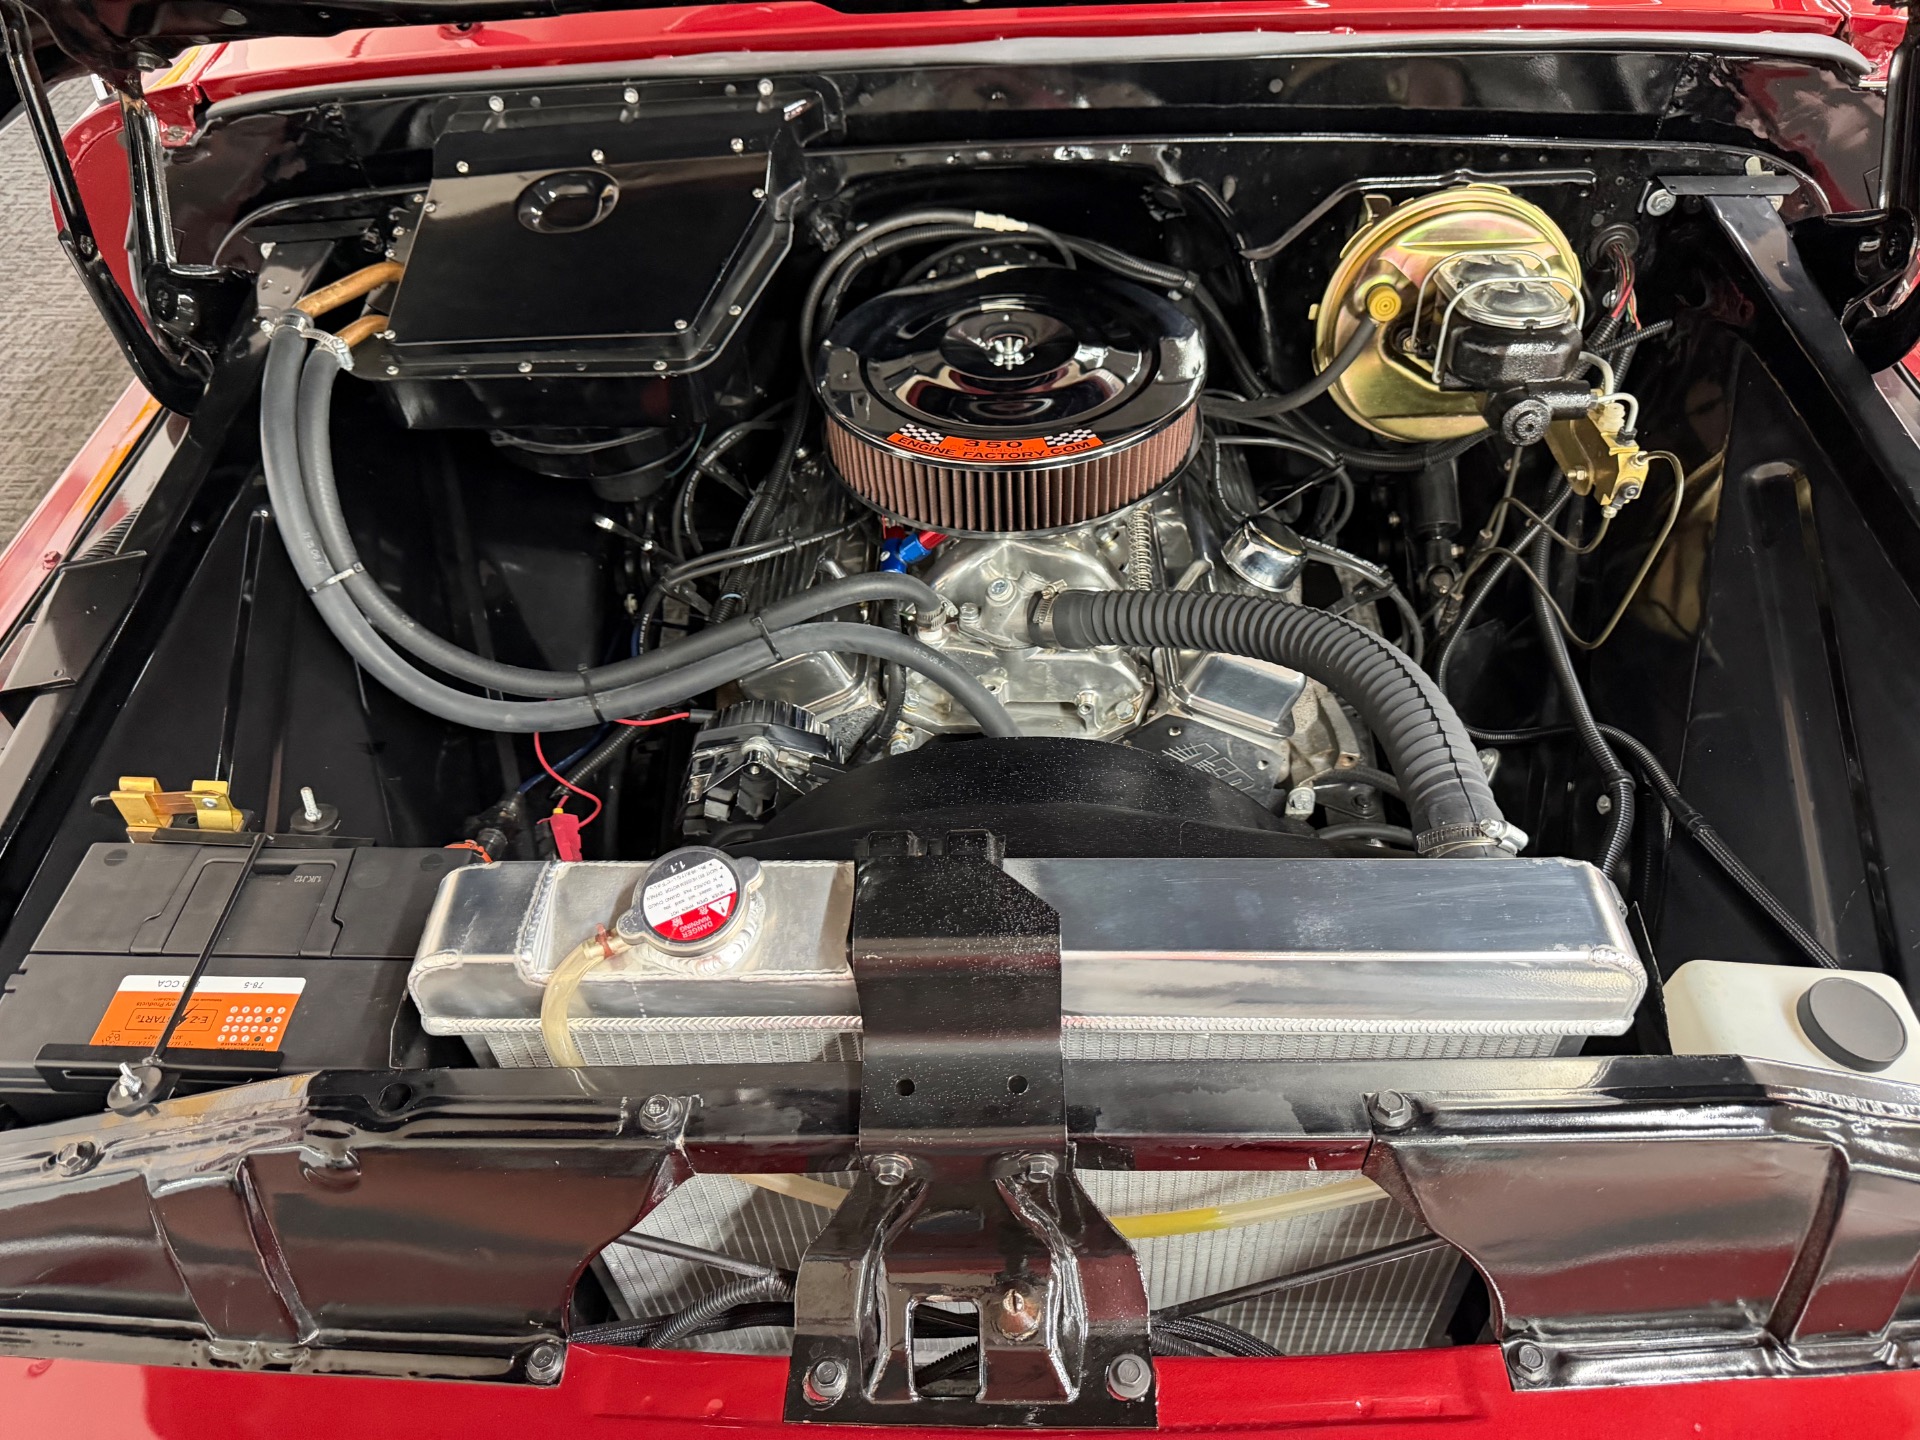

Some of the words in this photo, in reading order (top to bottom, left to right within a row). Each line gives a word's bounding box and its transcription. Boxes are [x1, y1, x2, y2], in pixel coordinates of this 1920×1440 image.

[898, 436, 956, 456] ENGINE
[962, 441, 1091, 459] FACTORY.COM
[964, 440, 1022, 449] 350
[670, 860, 686, 874] 1.1
[679, 916, 711, 932] WARNING
[682, 920, 713, 938] DANGER
[157, 980, 179, 988] CCA
[243, 981, 265, 989] 78-5
[189, 1015, 208, 1023] E-Z
